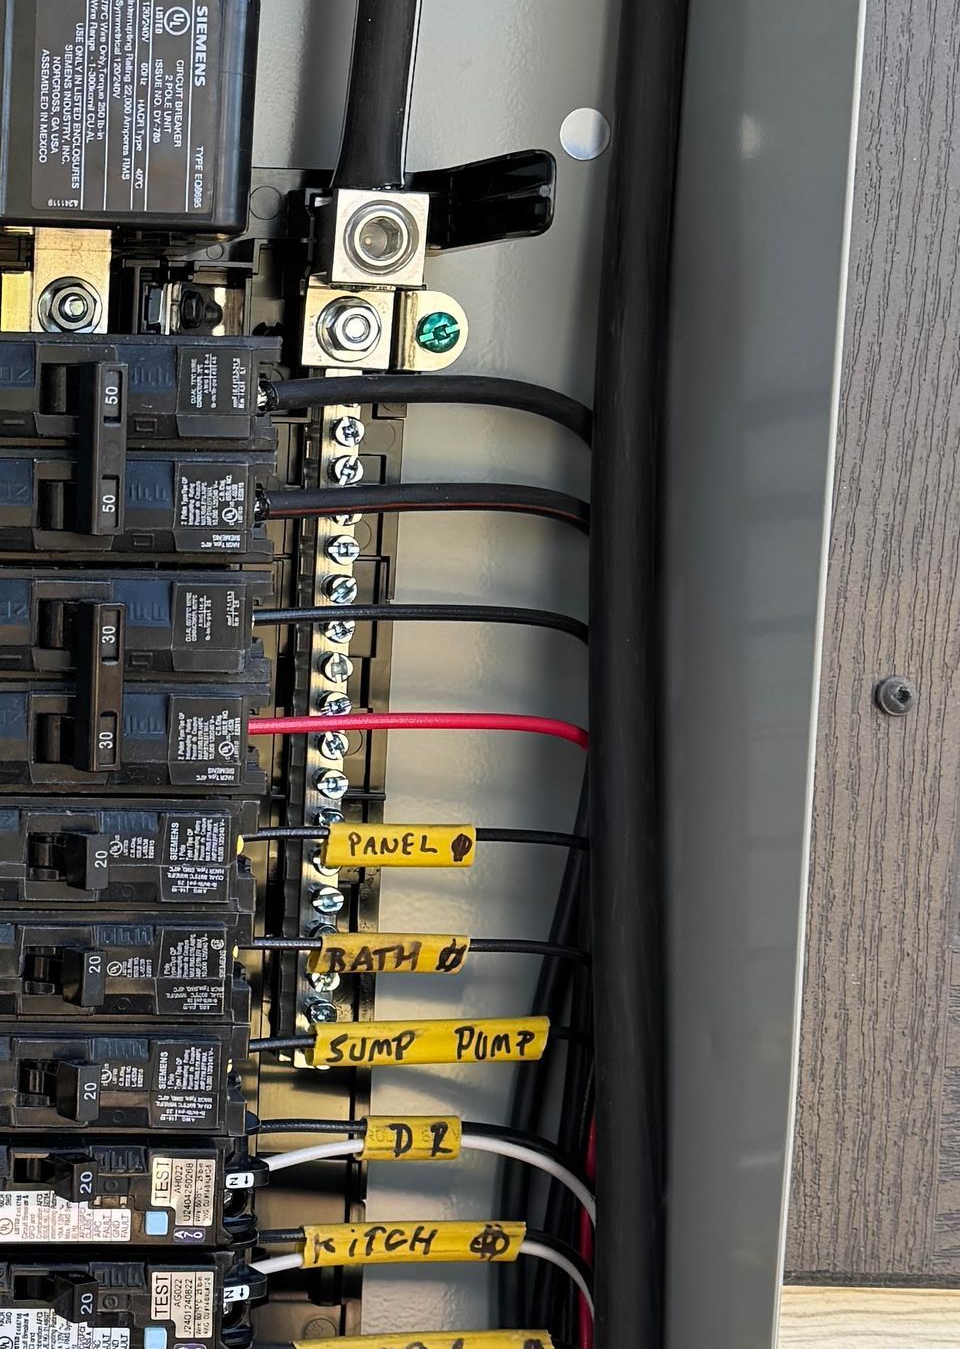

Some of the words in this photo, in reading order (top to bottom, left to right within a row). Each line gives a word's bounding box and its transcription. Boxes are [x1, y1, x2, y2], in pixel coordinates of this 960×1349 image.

[90, 0, 99, 20] Wire
[154, 6, 164, 35] LISTED
[75, 22, 84, 43] USE
[113, 0, 124, 55] Symmetrical
[125, 0, 135, 52] Interrupting
[74, 45, 84, 73] ONLY
[194, 5, 209, 88] SIEMENS
[40, 48, 50, 110] ASSEMBLED
[63, 44, 73, 89] SIEMENS
[122, 53, 134, 83] Rating
[154, 59, 163, 88] ISSUE
[174, 59, 185, 100] CIRCUIT
[50, 56, 61, 115] NORCROSS,
[153, 90, 162, 108] NO.
[163, 82, 173, 109] POLE
[62, 90, 72, 143] INDUSTRY,
[73, 86, 82, 121] LISTED
[121, 115, 131, 156] Amperes
[163, 110, 172, 133] UNIT
[173, 101, 183, 147] BREAKER
[38, 123, 48, 163] MEXICO
[50, 133, 59, 154] USA
[61, 144, 70, 165] INC.
[135, 128, 145, 152] Type
[71, 122, 81, 189] ENCLOSURES
[121, 158, 130, 180] RMS
[194, 146, 204, 171] TYPE
[105, 385, 119, 406] 50
[102, 494, 116, 514] 50
[102, 624, 116, 645] 30
[99, 730, 114, 750] 30
[170, 822, 179, 860] SIEMENS
[348, 832, 438, 857] PANEL
[95, 850, 108, 868] 20
[88, 955, 101, 974] 20
[324, 941, 423, 973] BATH
[325, 1030, 416, 1063] SUMP
[454, 1025, 536, 1060] PUMP
[158, 1051, 168, 1090] SIEMENS
[83, 1082, 97, 1100] 20
[79, 1170, 93, 1194] 20
[154, 1160, 171, 1203] TEST
[80, 1292, 93, 1315] 20
[154, 1274, 170, 1318] TEST
